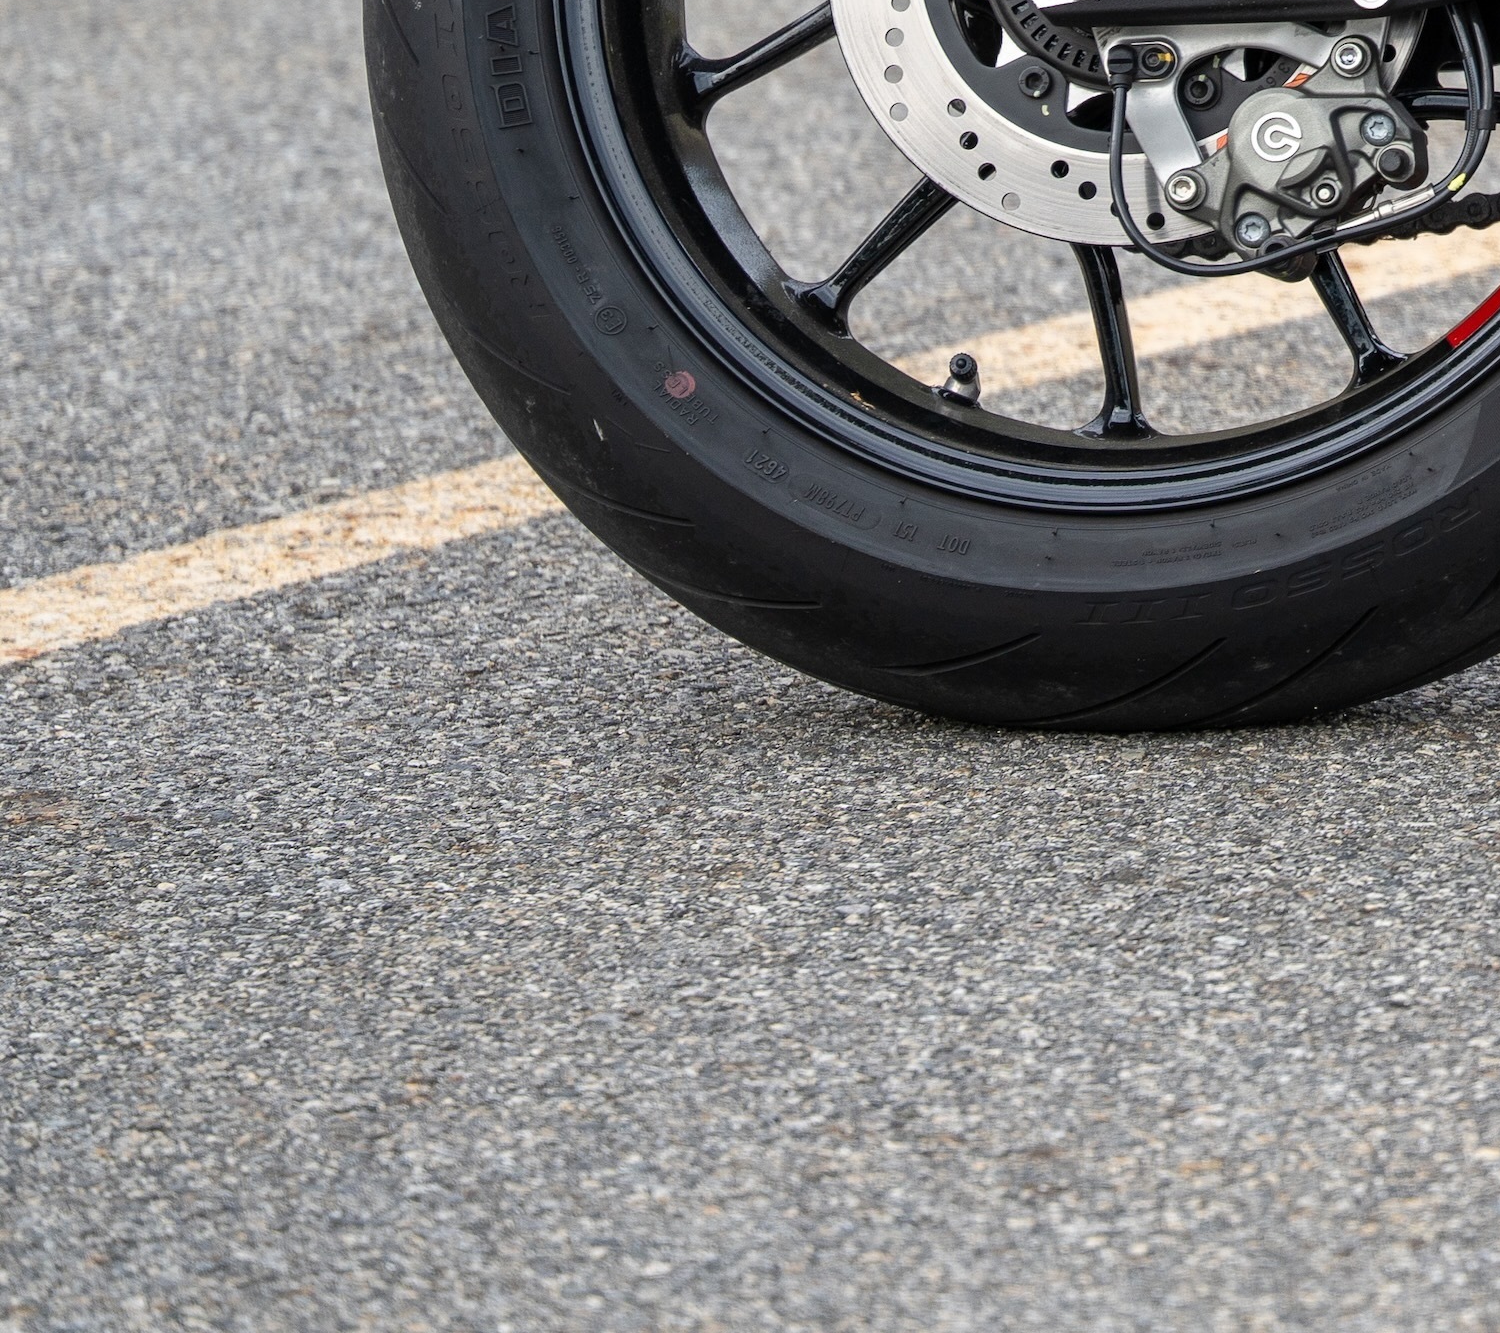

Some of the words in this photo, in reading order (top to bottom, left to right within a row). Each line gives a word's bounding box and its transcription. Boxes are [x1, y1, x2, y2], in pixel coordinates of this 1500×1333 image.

[648, 375, 701, 429] RADIAL
[739, 441, 791, 488] 4621
[934, 530, 973, 557] DOT
